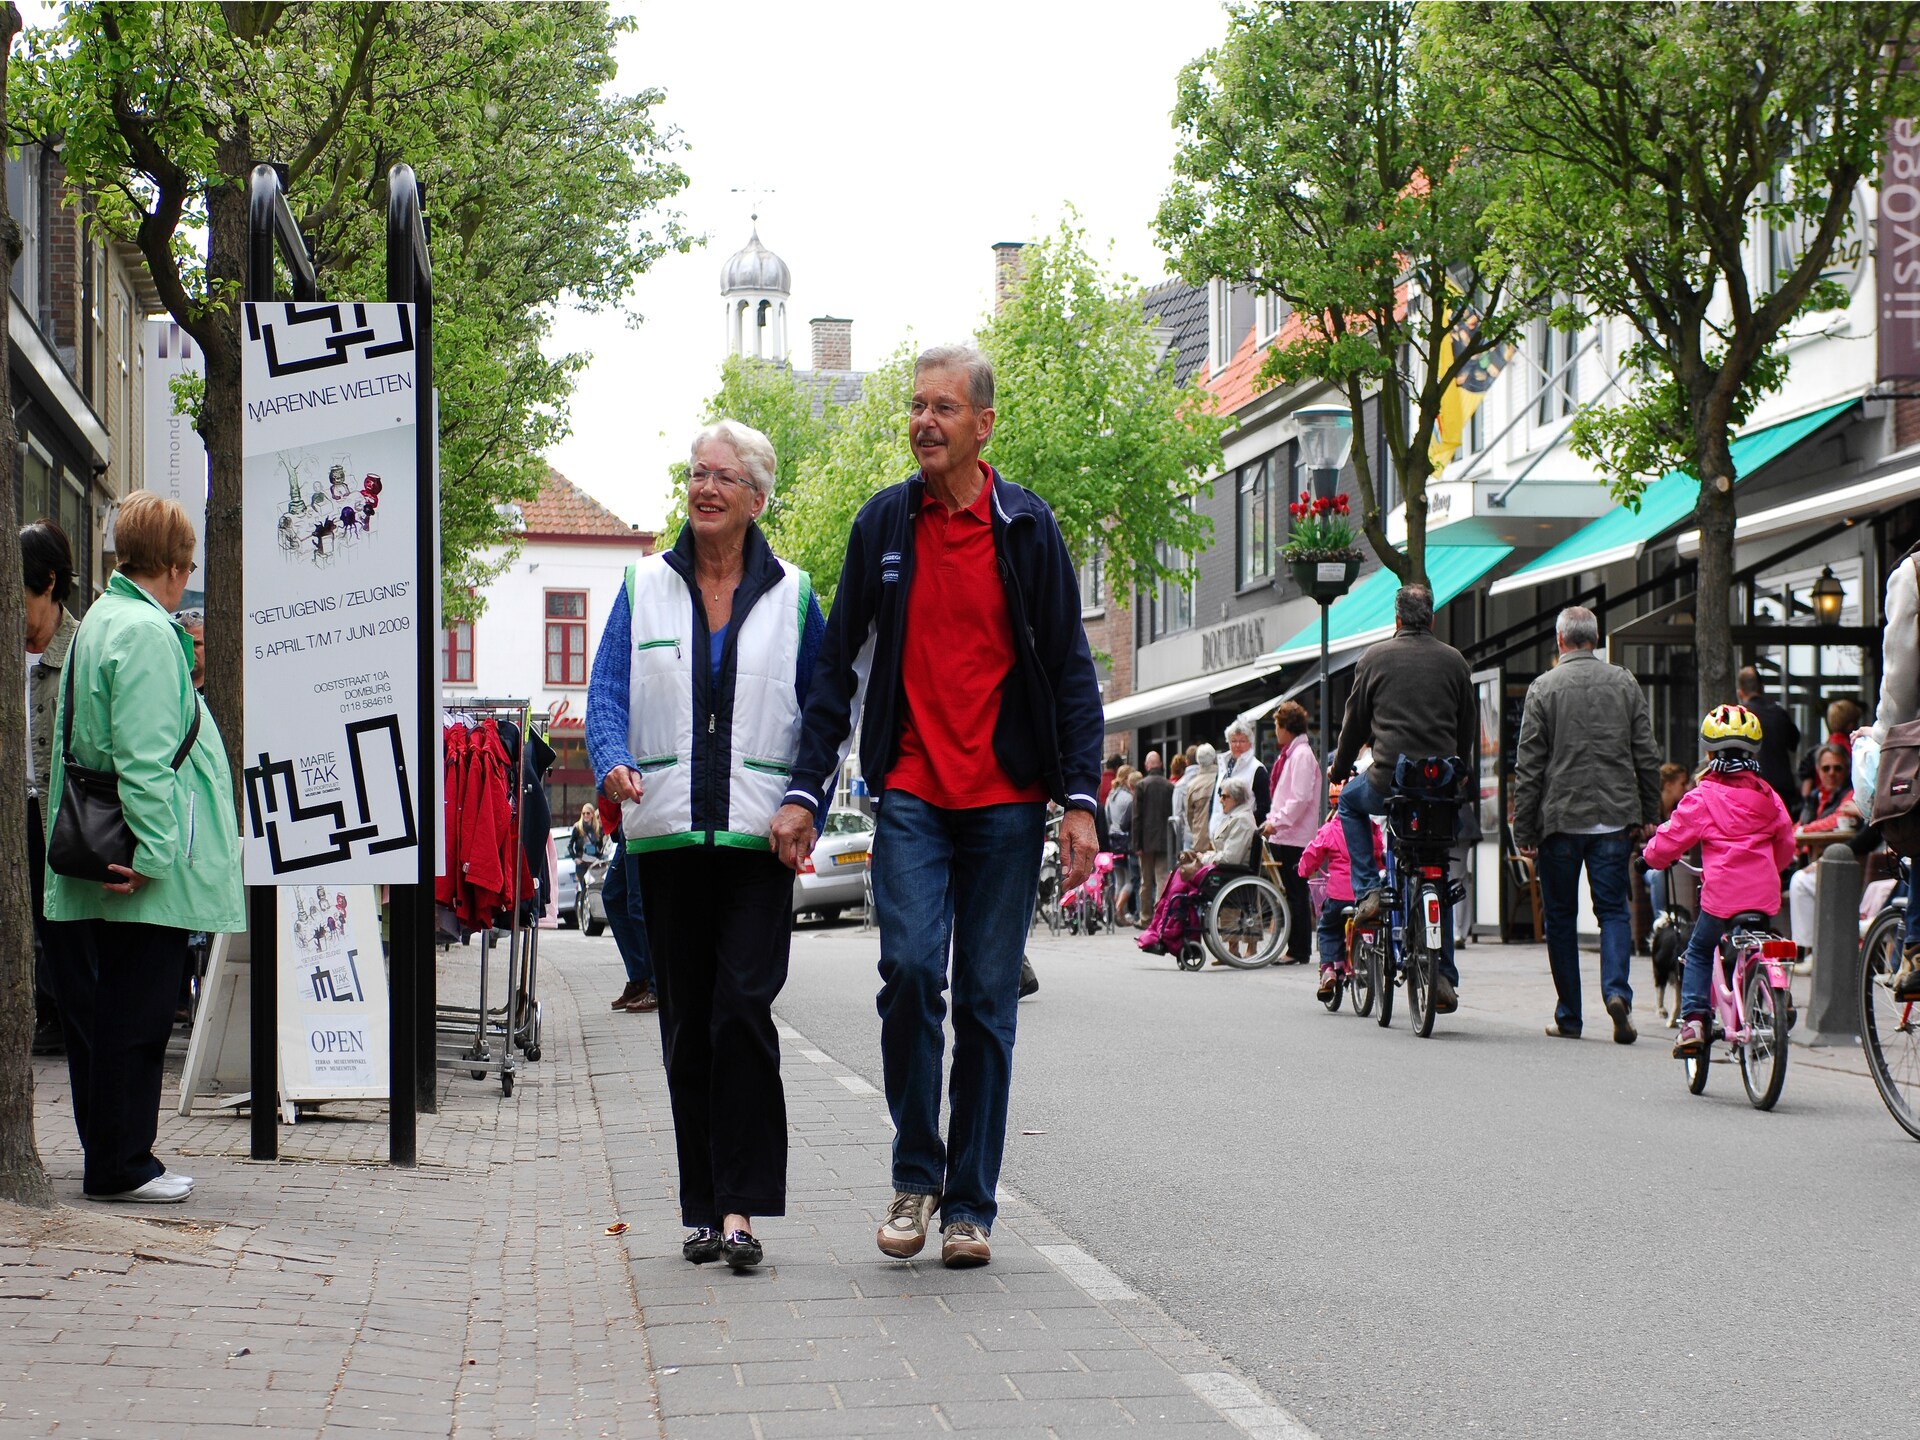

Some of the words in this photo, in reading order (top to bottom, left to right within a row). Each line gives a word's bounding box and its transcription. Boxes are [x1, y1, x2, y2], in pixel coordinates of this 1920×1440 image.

[248, 386, 338, 419] MARENNE
[340, 372, 412, 401] WELTEN
[249, 596, 336, 625] “GETUIGENIS
[338, 594, 343, 608] /
[347, 581, 410, 607] ZEUGNIS”
[255, 646, 263, 660] 5
[266, 638, 305, 658] APRIL
[306, 631, 332, 649] T/M
[334, 630, 342, 643] 7
[346, 622, 376, 641] JUNI
[378, 616, 410, 635] 2009
[1202, 617, 1265, 671] BOUWMAN
[313, 673, 371, 694] OOSTSTRAAT
[373, 670, 389, 682] 10A
[344, 682, 391, 700] DOMBURG
[340, 700, 361, 713] 0118
[362, 695, 393, 709] 584618
[300, 751, 336, 768] MARIE
[301, 763, 339, 786] TAK
[334, 973, 349, 985] TAK
[311, 1030, 364, 1053] OPEN
